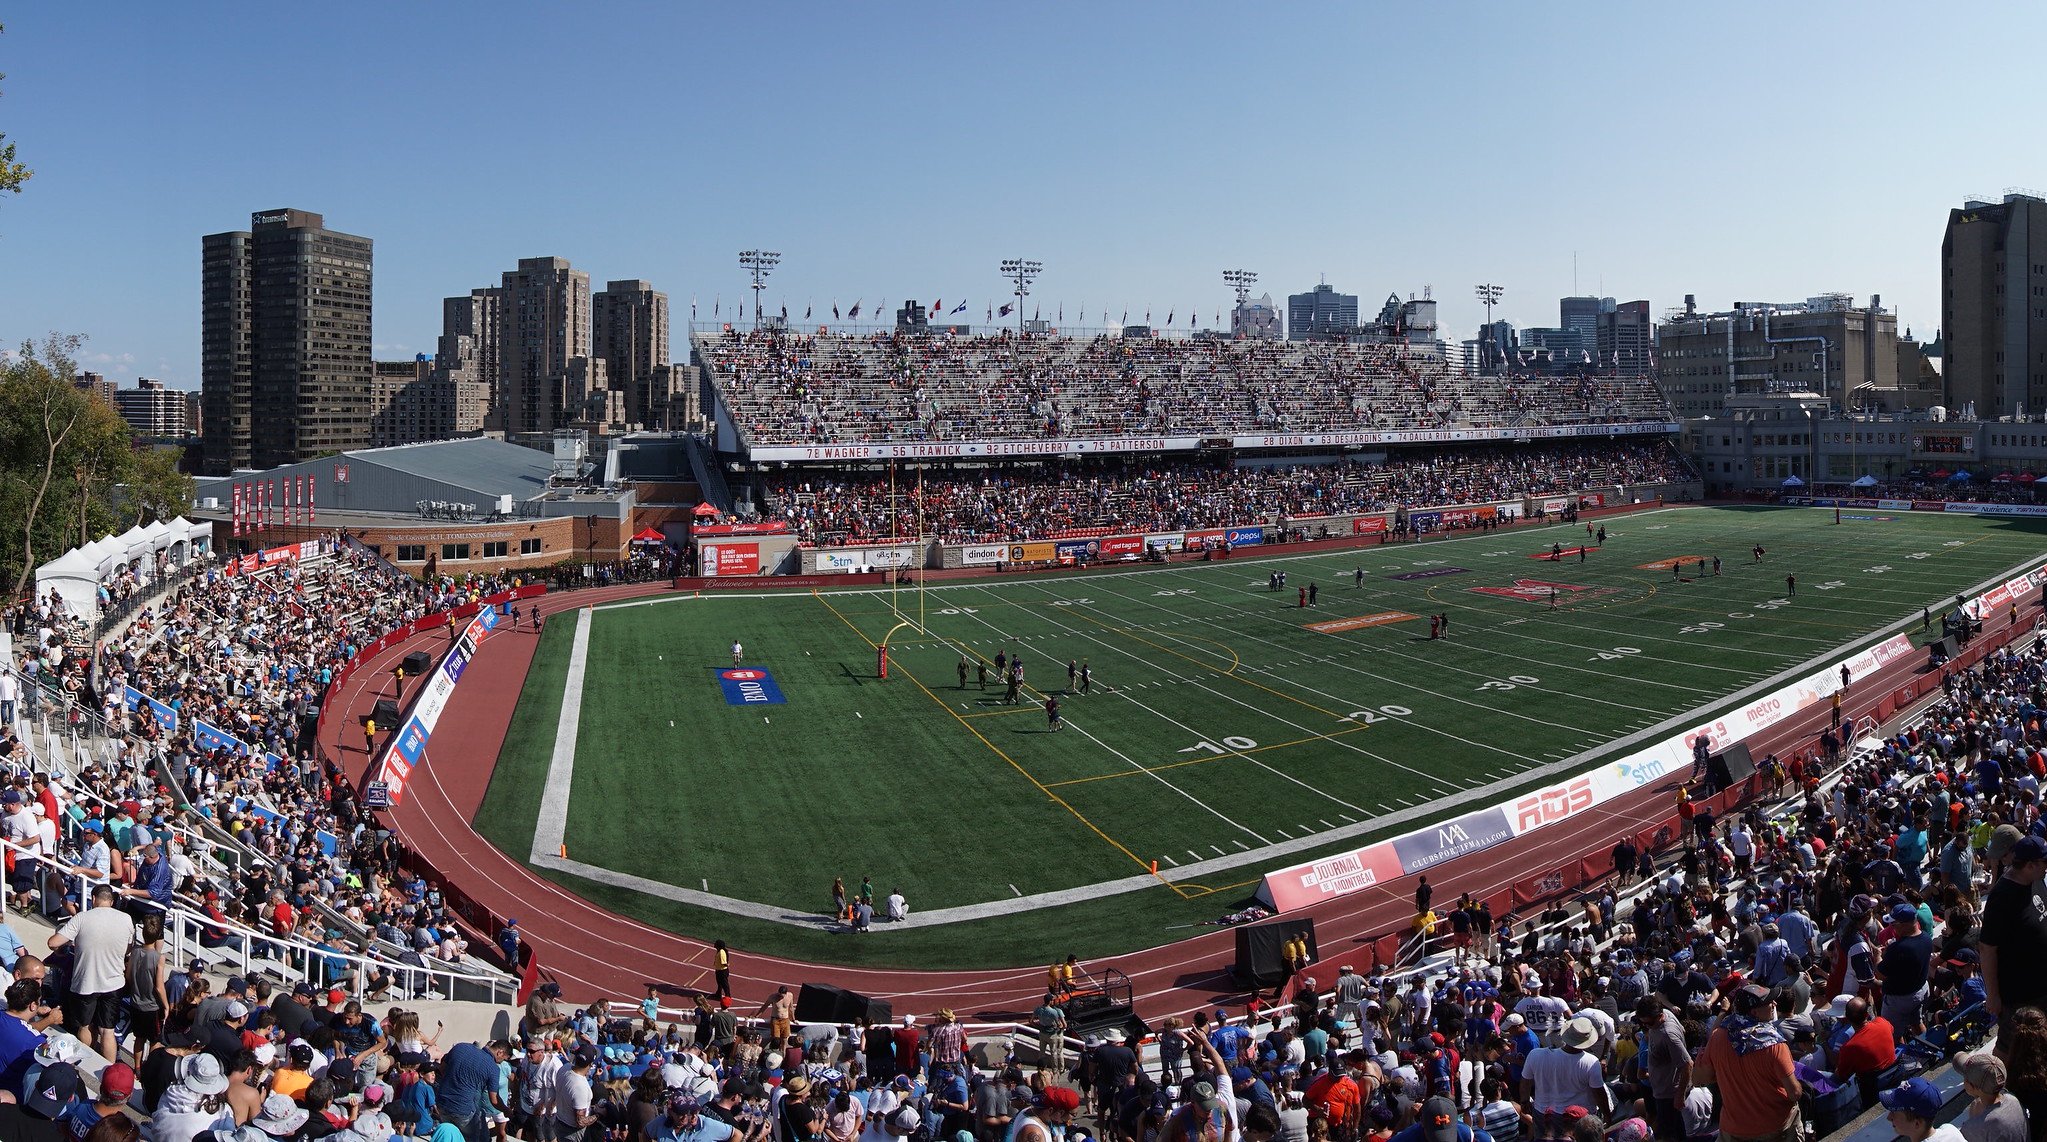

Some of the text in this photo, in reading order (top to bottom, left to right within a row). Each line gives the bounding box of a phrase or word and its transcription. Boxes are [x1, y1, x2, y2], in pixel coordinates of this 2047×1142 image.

[1576, 427, 1609, 435] CALVILLO
[1635, 424, 1667, 433] CAHOON
[1321, 434, 1382, 444] 63 DESJARDINS
[1399, 432, 1452, 441] 74 DALLA RIVA
[1466, 431, 1473, 439] 77
[1486, 430, 1498, 438] YOU
[1093, 439, 1165, 450] 75 PATTERSON
[1264, 436, 1303, 445] 28 DIXON
[807, 447, 869, 458] 78 WAGNER
[893, 445, 961, 457] 56 TRAWICK
[986, 442, 1070, 454] 92 ETCHEVERRY
[446, 532, 486, 540] TOMLINSON
[1240, 532, 1260, 541] pepsi
[1122, 542, 1140, 550] tag.ca
[969, 550, 995, 558] dindon
[834, 558, 852, 567] stm
[703, 579, 754, 588] Budweiser
[1597, 646, 1642, 661] 40
[1873, 641, 1912, 663] Tim Hortons
[1849, 656, 1874, 676] urolator
[1482, 675, 1540, 691] 30
[738, 681, 768, 703] BMO
[1348, 705, 1414, 724] 20
[1746, 698, 1781, 723] metro
[1756, 720, 1767, 728] mon
[1195, 736, 1258, 755] 10
[1632, 758, 1666, 785] stm
[1517, 777, 1593, 832] RDS
[1305, 856, 1361, 885] LE JOURNAL
